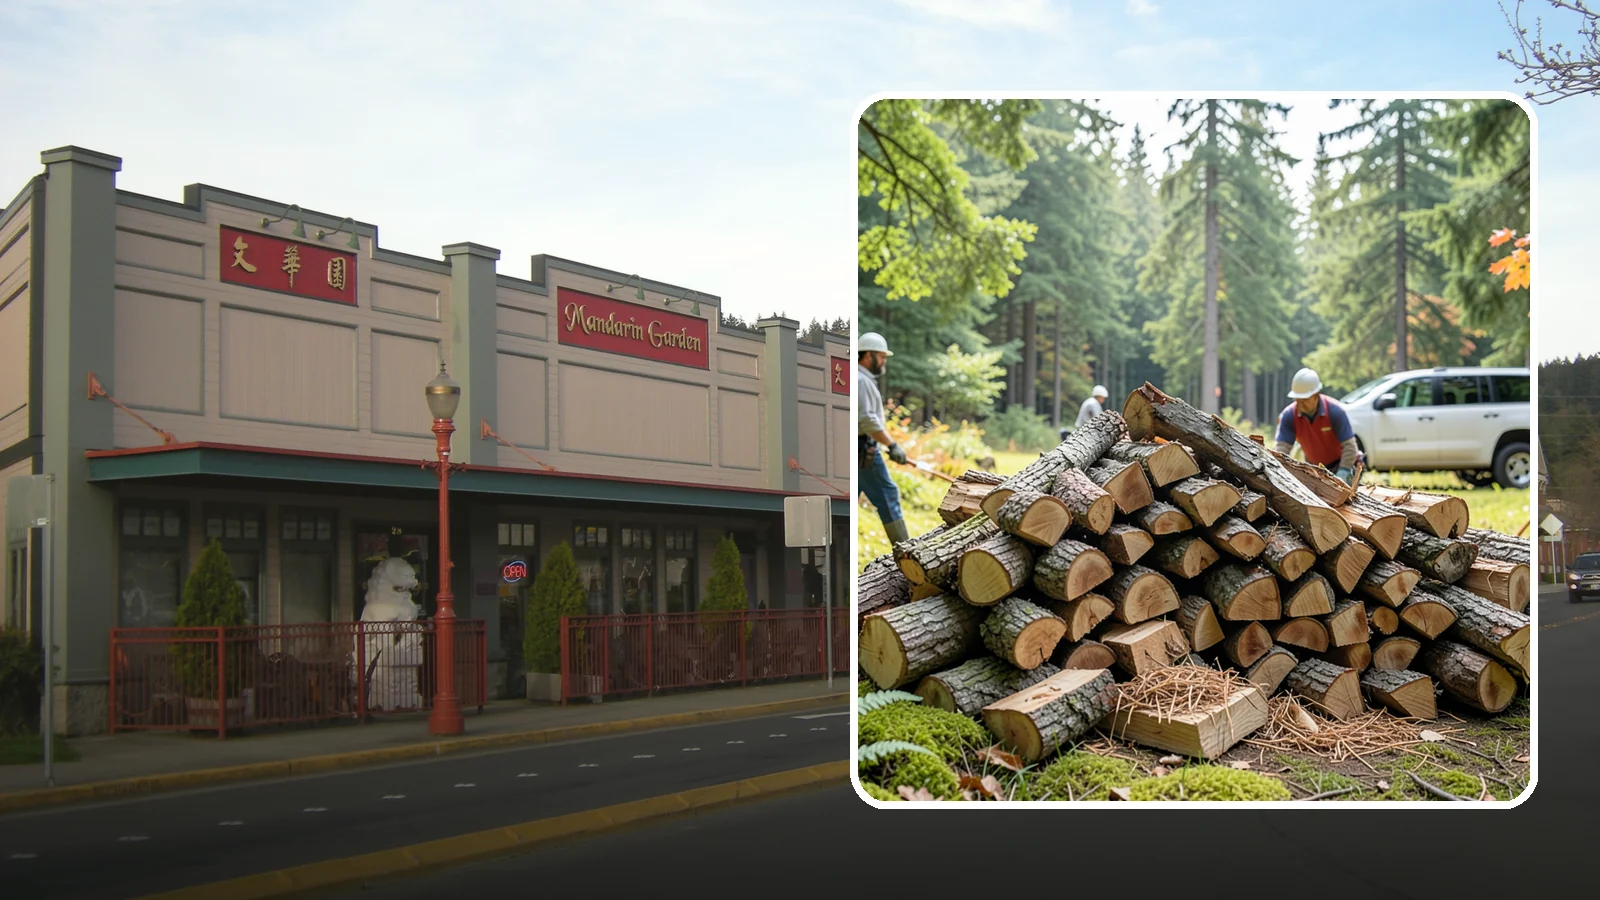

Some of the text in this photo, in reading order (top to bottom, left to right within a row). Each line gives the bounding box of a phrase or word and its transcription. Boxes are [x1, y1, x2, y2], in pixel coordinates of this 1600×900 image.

[231, 235, 347, 290] 文華園
[564, 302, 702, 352] Mandarin Garden
[503, 565, 527, 578] OPEN
